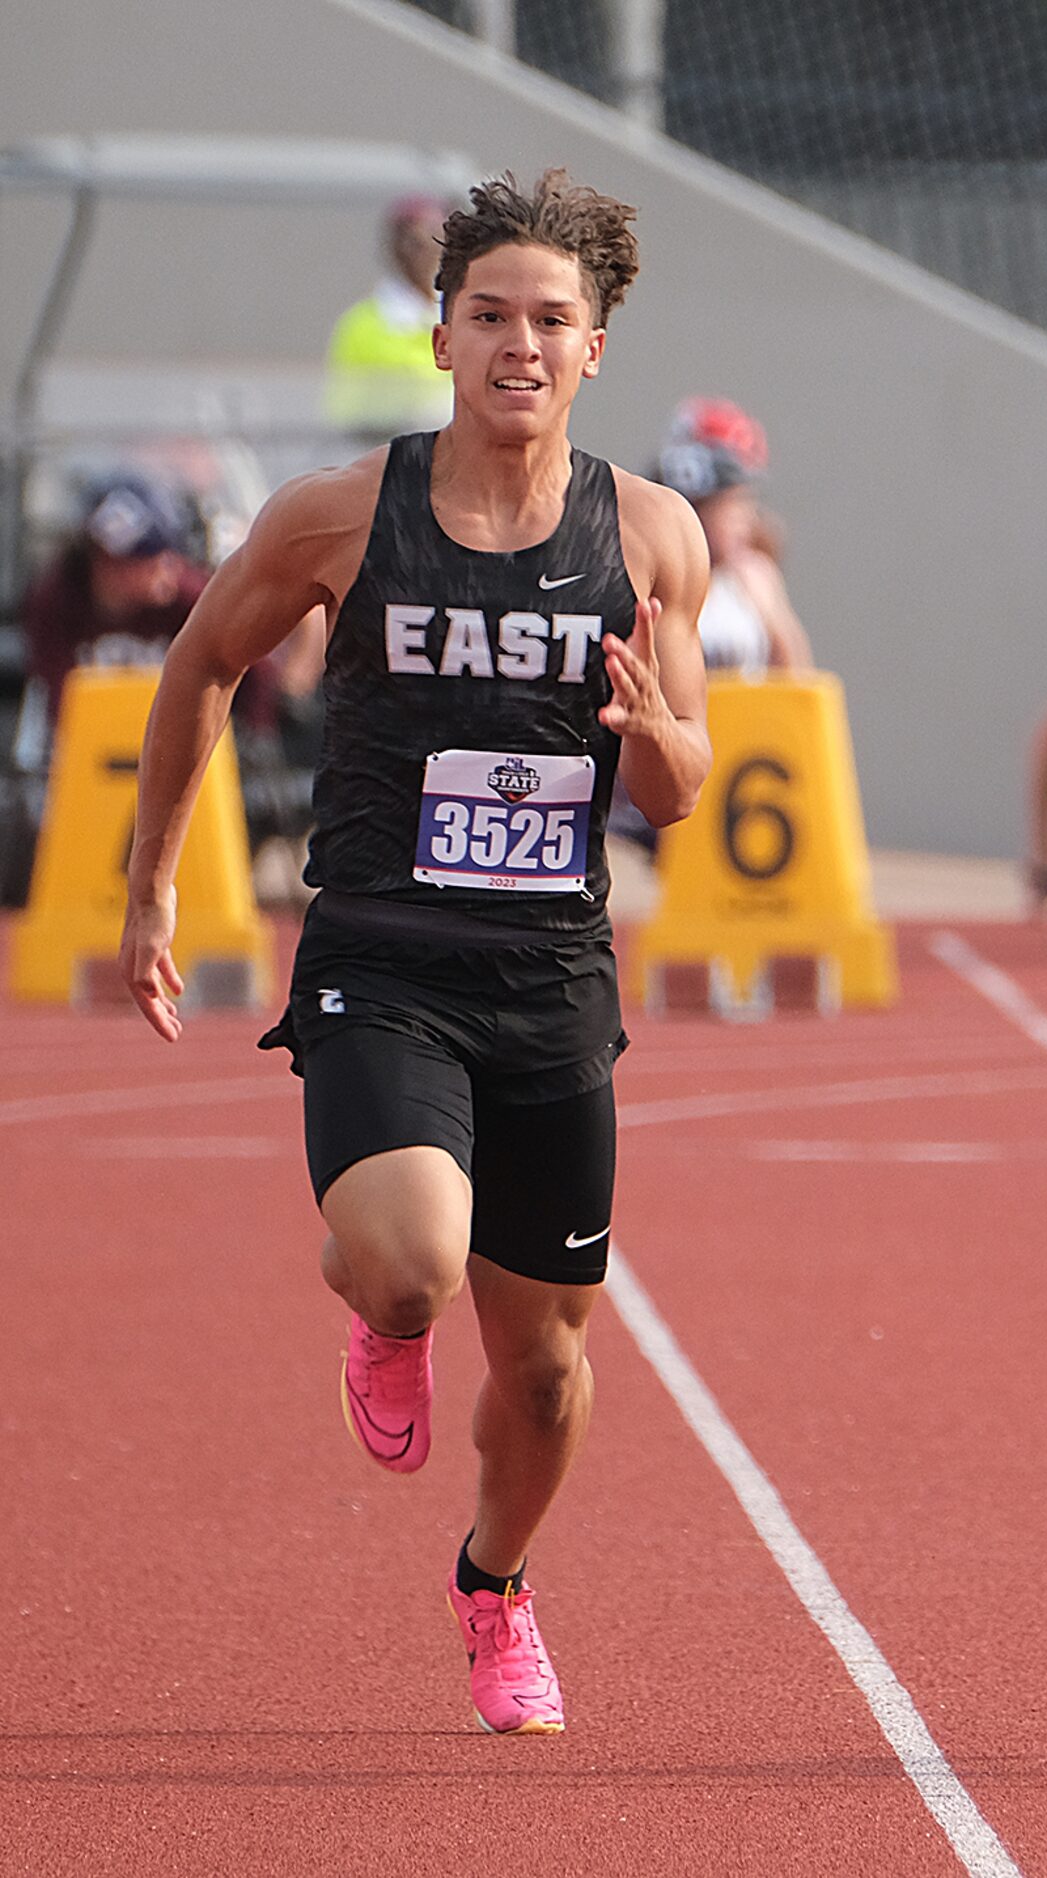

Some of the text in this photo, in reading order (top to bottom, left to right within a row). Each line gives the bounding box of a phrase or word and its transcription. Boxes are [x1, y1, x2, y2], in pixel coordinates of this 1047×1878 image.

[385, 603, 602, 683] EAST
[489, 774, 539, 789] STATE
[430, 801, 575, 870] 3525
[725, 757, 793, 880] 6
[488, 877, 517, 888] 2023
